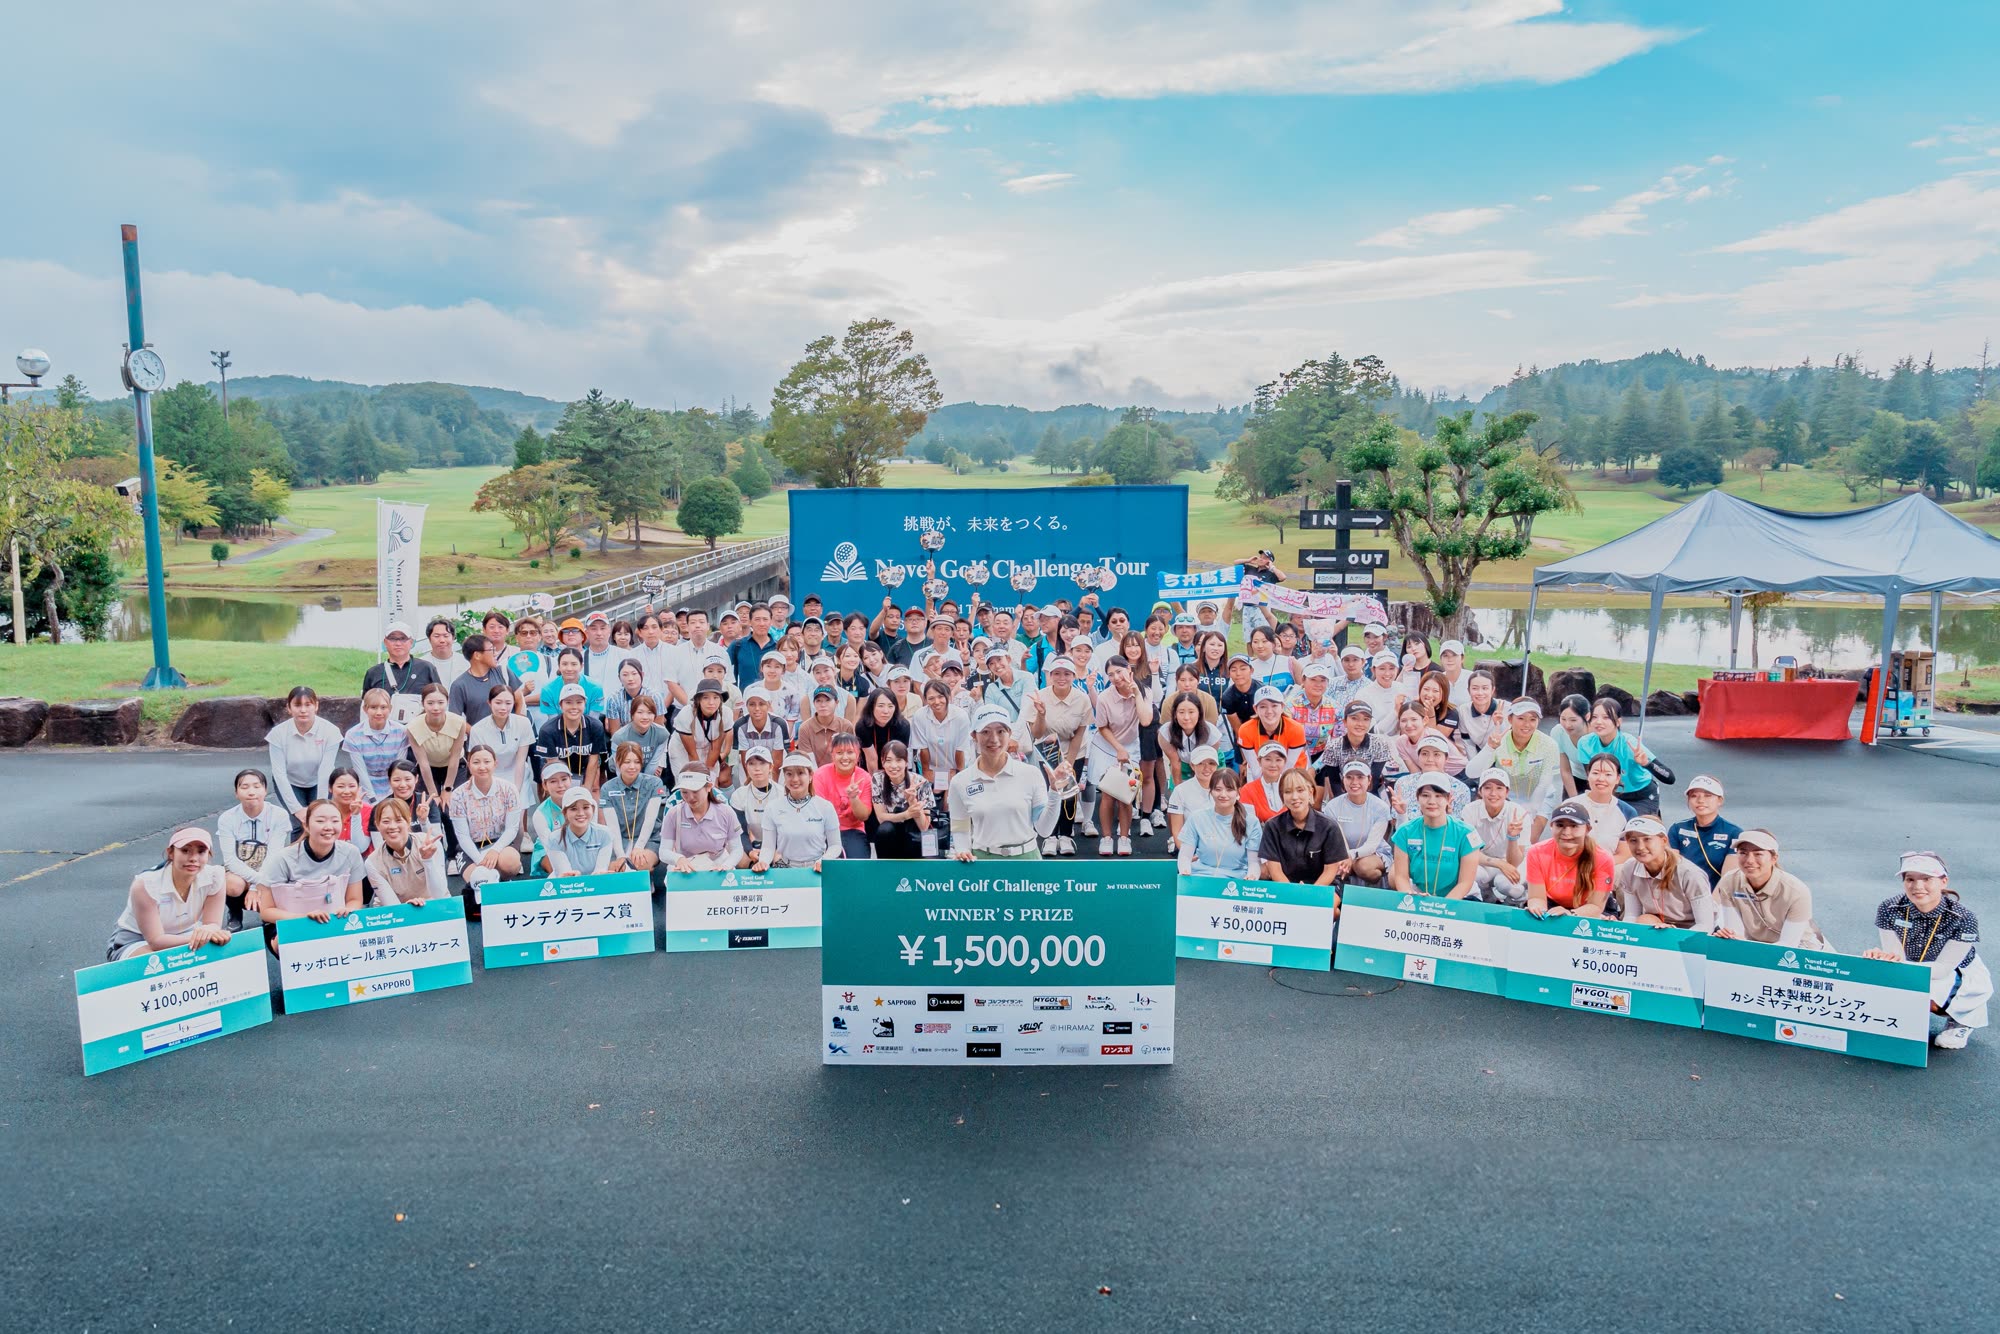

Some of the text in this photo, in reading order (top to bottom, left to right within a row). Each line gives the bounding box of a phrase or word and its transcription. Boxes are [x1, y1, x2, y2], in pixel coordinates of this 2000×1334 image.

[1312, 514, 1338, 526] IN
[1348, 553, 1383, 565] OUT
[914, 878, 1098, 895] Novel Golf Challenge Tour
[503, 902, 633, 929] サンテグラース賞
[706, 904, 789, 916] ZEROFITグローブ
[1020, 908, 1073, 922] PRIZE
[359, 935, 394, 948] 優勝副賞
[1383, 928, 1464, 950] 50,000円商品券
[290, 937, 461, 974] サッポロビール黒ラベル3ケース
[1804, 957, 1838, 967] Novel Golf
[1804, 963, 1851, 976] Challenge Tour
[371, 978, 411, 992] SAPPORO
[1792, 977, 1834, 992] 優勝副賞
[1574, 986, 1610, 999] MYGOL
[1761, 985, 1866, 1010] 日本製紙クレシア
[1730, 991, 1899, 1029] カシミヤティッシュ2ケース
[1103, 1046, 1131, 1054] ワンスポ
